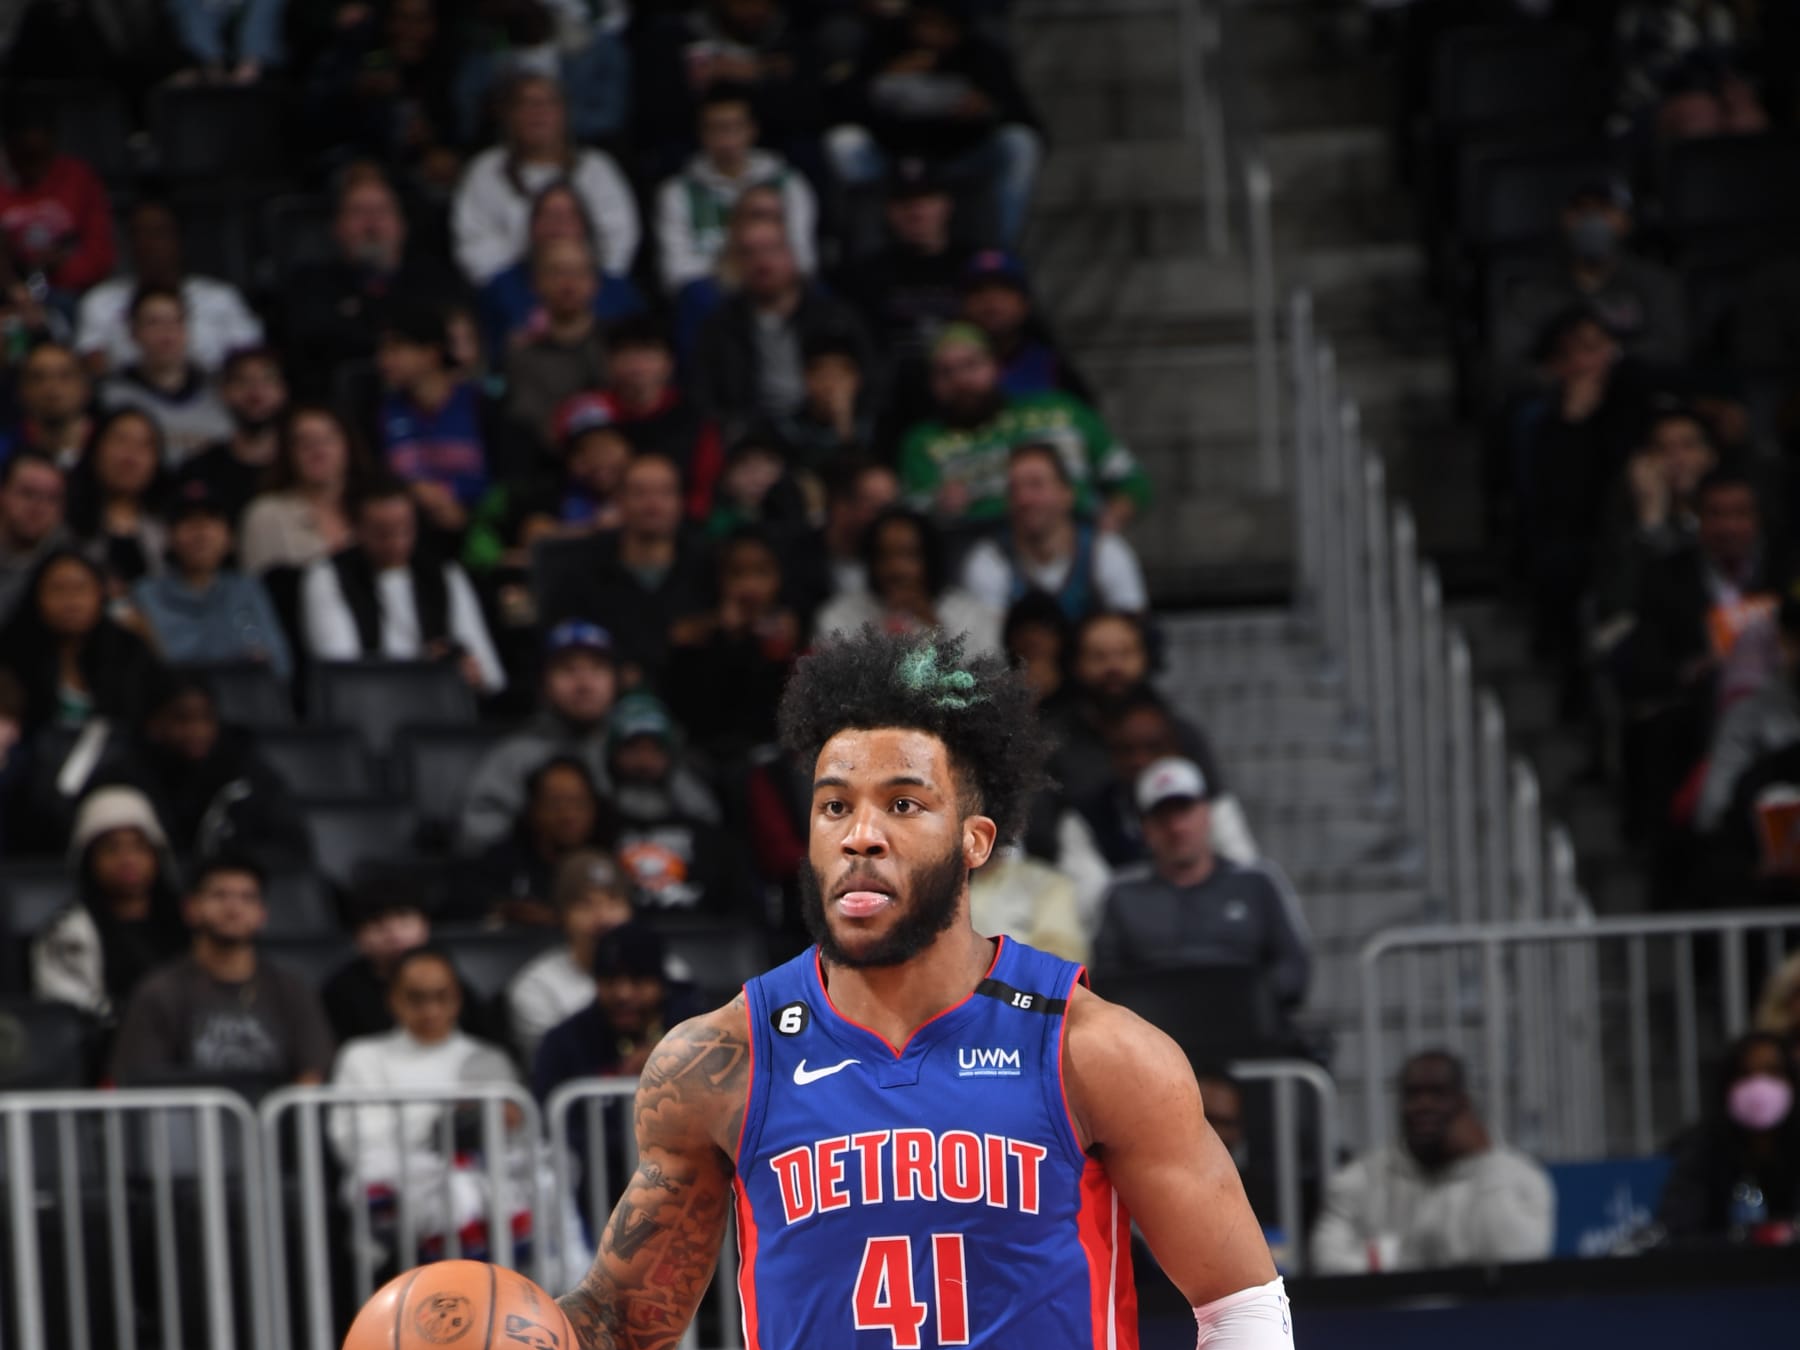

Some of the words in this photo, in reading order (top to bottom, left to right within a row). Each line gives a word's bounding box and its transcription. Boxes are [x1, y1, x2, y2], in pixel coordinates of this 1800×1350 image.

[1011, 992, 1034, 1009] 16
[778, 1005, 802, 1034] 6
[958, 1047, 1021, 1070] UWM
[770, 1127, 1047, 1226] DETROIT
[852, 1232, 970, 1350] 41
